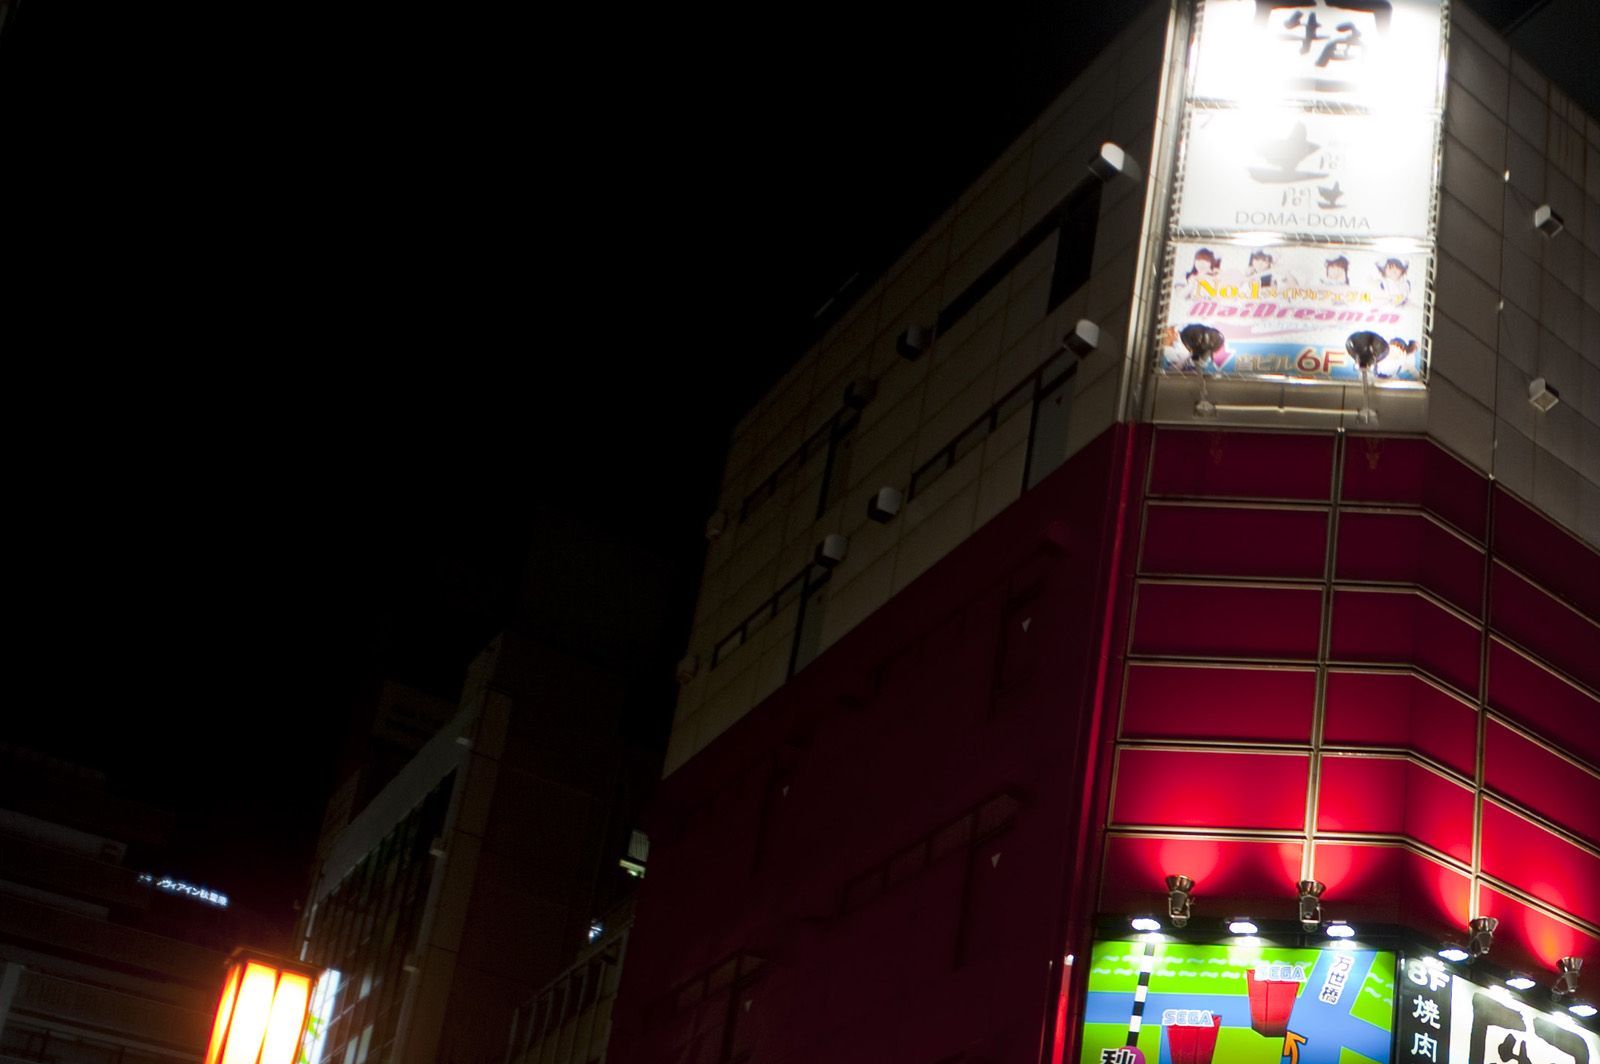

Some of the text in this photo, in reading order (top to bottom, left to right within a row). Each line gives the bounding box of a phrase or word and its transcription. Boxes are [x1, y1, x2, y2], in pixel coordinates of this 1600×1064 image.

[1235, 210, 1371, 230] DOMA-DOMA
[1189, 301, 1404, 324] MaiDreamin
[1319, 955, 1354, 1004] 万世橋
[1162, 1009, 1215, 1028] SEGA
